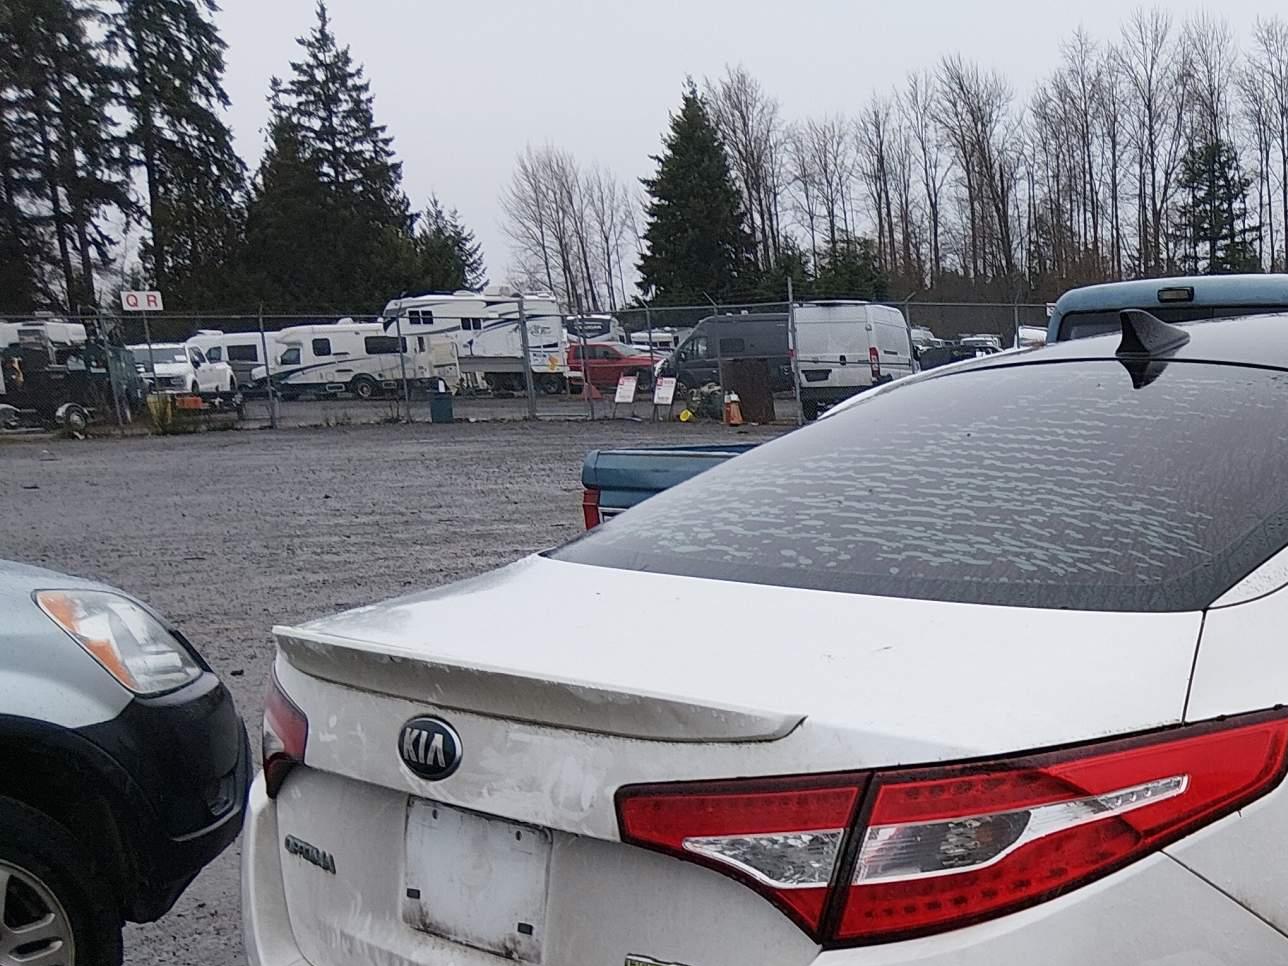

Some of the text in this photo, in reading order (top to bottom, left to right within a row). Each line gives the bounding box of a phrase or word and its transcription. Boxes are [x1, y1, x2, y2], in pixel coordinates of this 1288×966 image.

[126, 294, 158, 307] Q R
[403, 727, 447, 768] KIA
